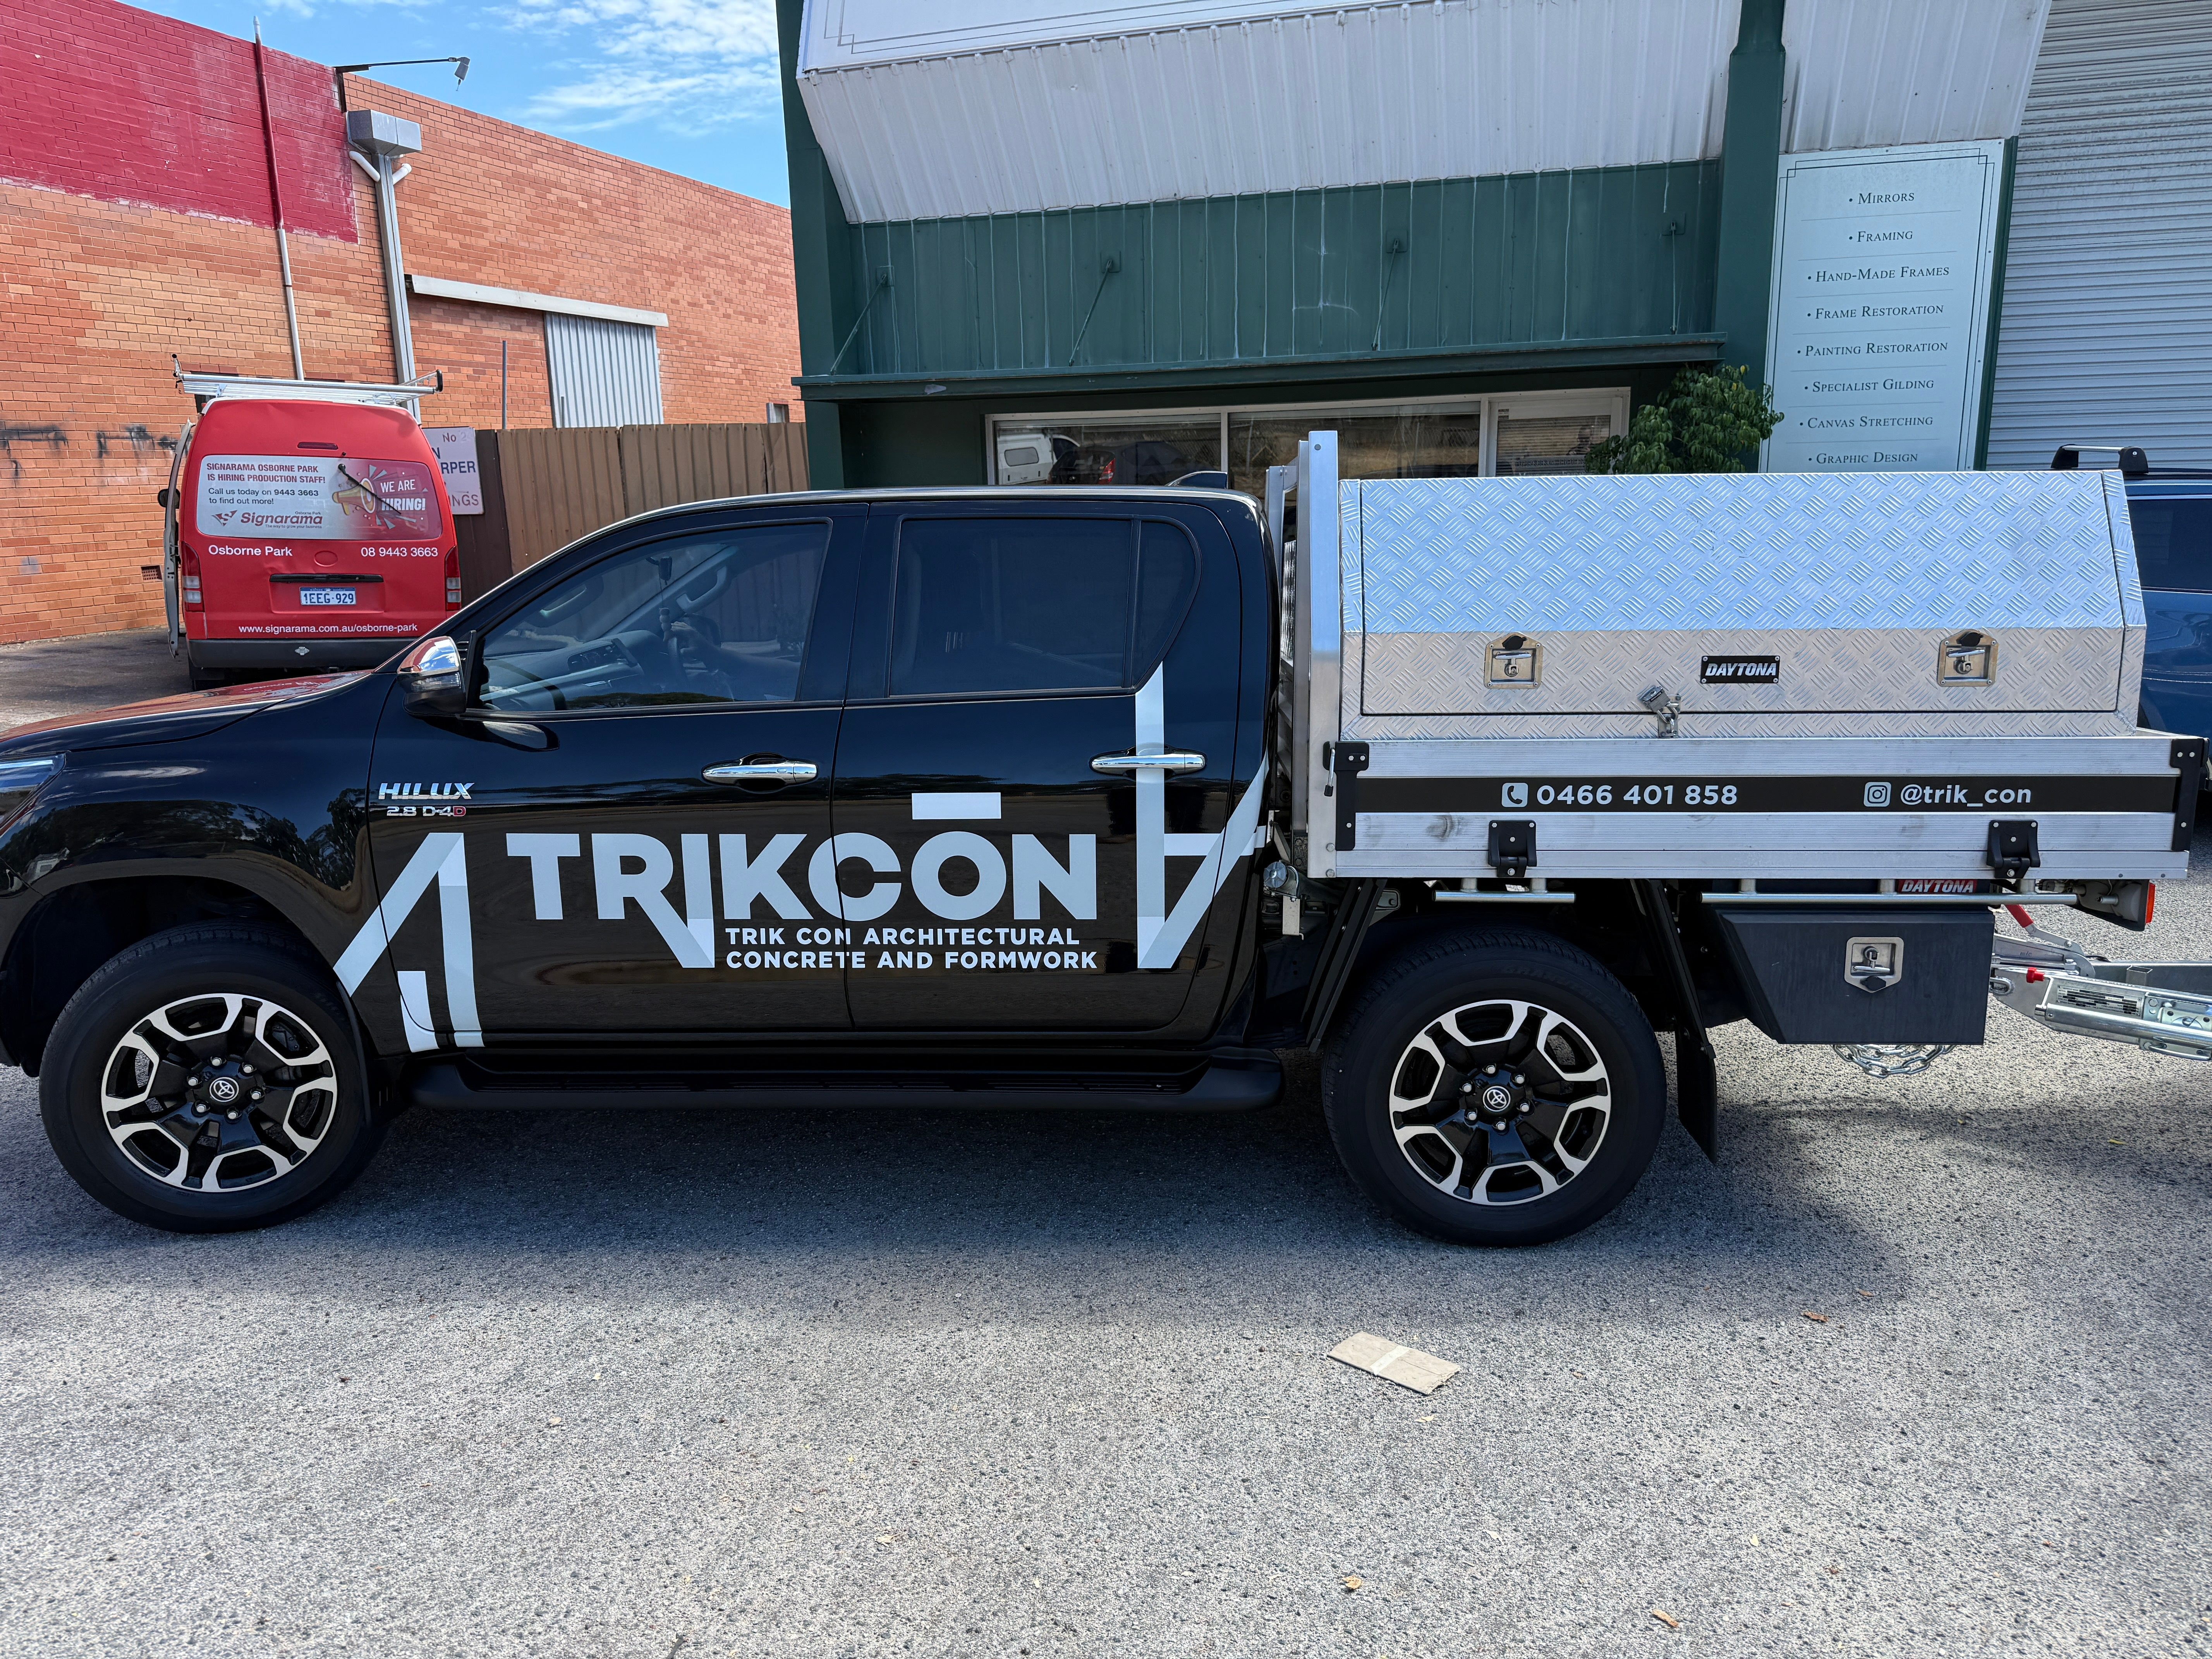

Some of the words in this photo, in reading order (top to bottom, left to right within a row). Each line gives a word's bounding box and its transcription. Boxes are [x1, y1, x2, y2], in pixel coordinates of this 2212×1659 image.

[1858, 193, 1914, 204] MIRRORS
[1858, 231, 1912, 242] FRAMING
[1816, 268, 1895, 282] HAND-MADE
[1901, 266, 1949, 277] FRAMES
[1816, 308, 1856, 319] FRAME
[1862, 306, 1943, 316] RESTORATION
[1806, 346, 1860, 356] PAINTING
[1866, 343, 1948, 353] RESTORATION
[1813, 382, 1878, 392] SPECIALIST
[1883, 379, 1933, 390] GILDING
[1808, 418, 1854, 428] CANVAS
[1860, 416, 1932, 427] STRETCHING
[443, 433, 456, 442] No
[431, 447, 440, 459] N
[1817, 453, 1868, 464] GRAPHIC
[1874, 452, 1917, 462] DESIGN
[440, 461, 476, 474] RPER
[381, 481, 395, 493] WE
[398, 479, 416, 491] ARE
[381, 498, 425, 511] HIRING!
[240, 512, 323, 526] Signarama
[209, 545, 261, 555] Osborne
[265, 546, 292, 556] Park
[361, 548, 375, 556] 08
[379, 547, 407, 556] 9443
[411, 548, 438, 556] 3663
[239, 623, 417, 634] www.signarama.com.au/osborne-park
[1705, 663, 1776, 676] DAYTONA
[378, 782, 475, 800] HILUX
[1537, 785, 1612, 804] 0466
[1623, 785, 1673, 804] 401
[1685, 785, 1736, 804] 858
[1901, 784, 2031, 807] @trik_con
[1901, 879, 1973, 893] DAYTONA
[725, 928, 785, 944] TRIK
[797, 928, 850, 945] CON
[863, 928, 1079, 945] ARCHITECTURAL
[726, 951, 865, 968] CONCRETE
[877, 951, 933, 969] AND
[946, 951, 1097, 969] FORMWORK
